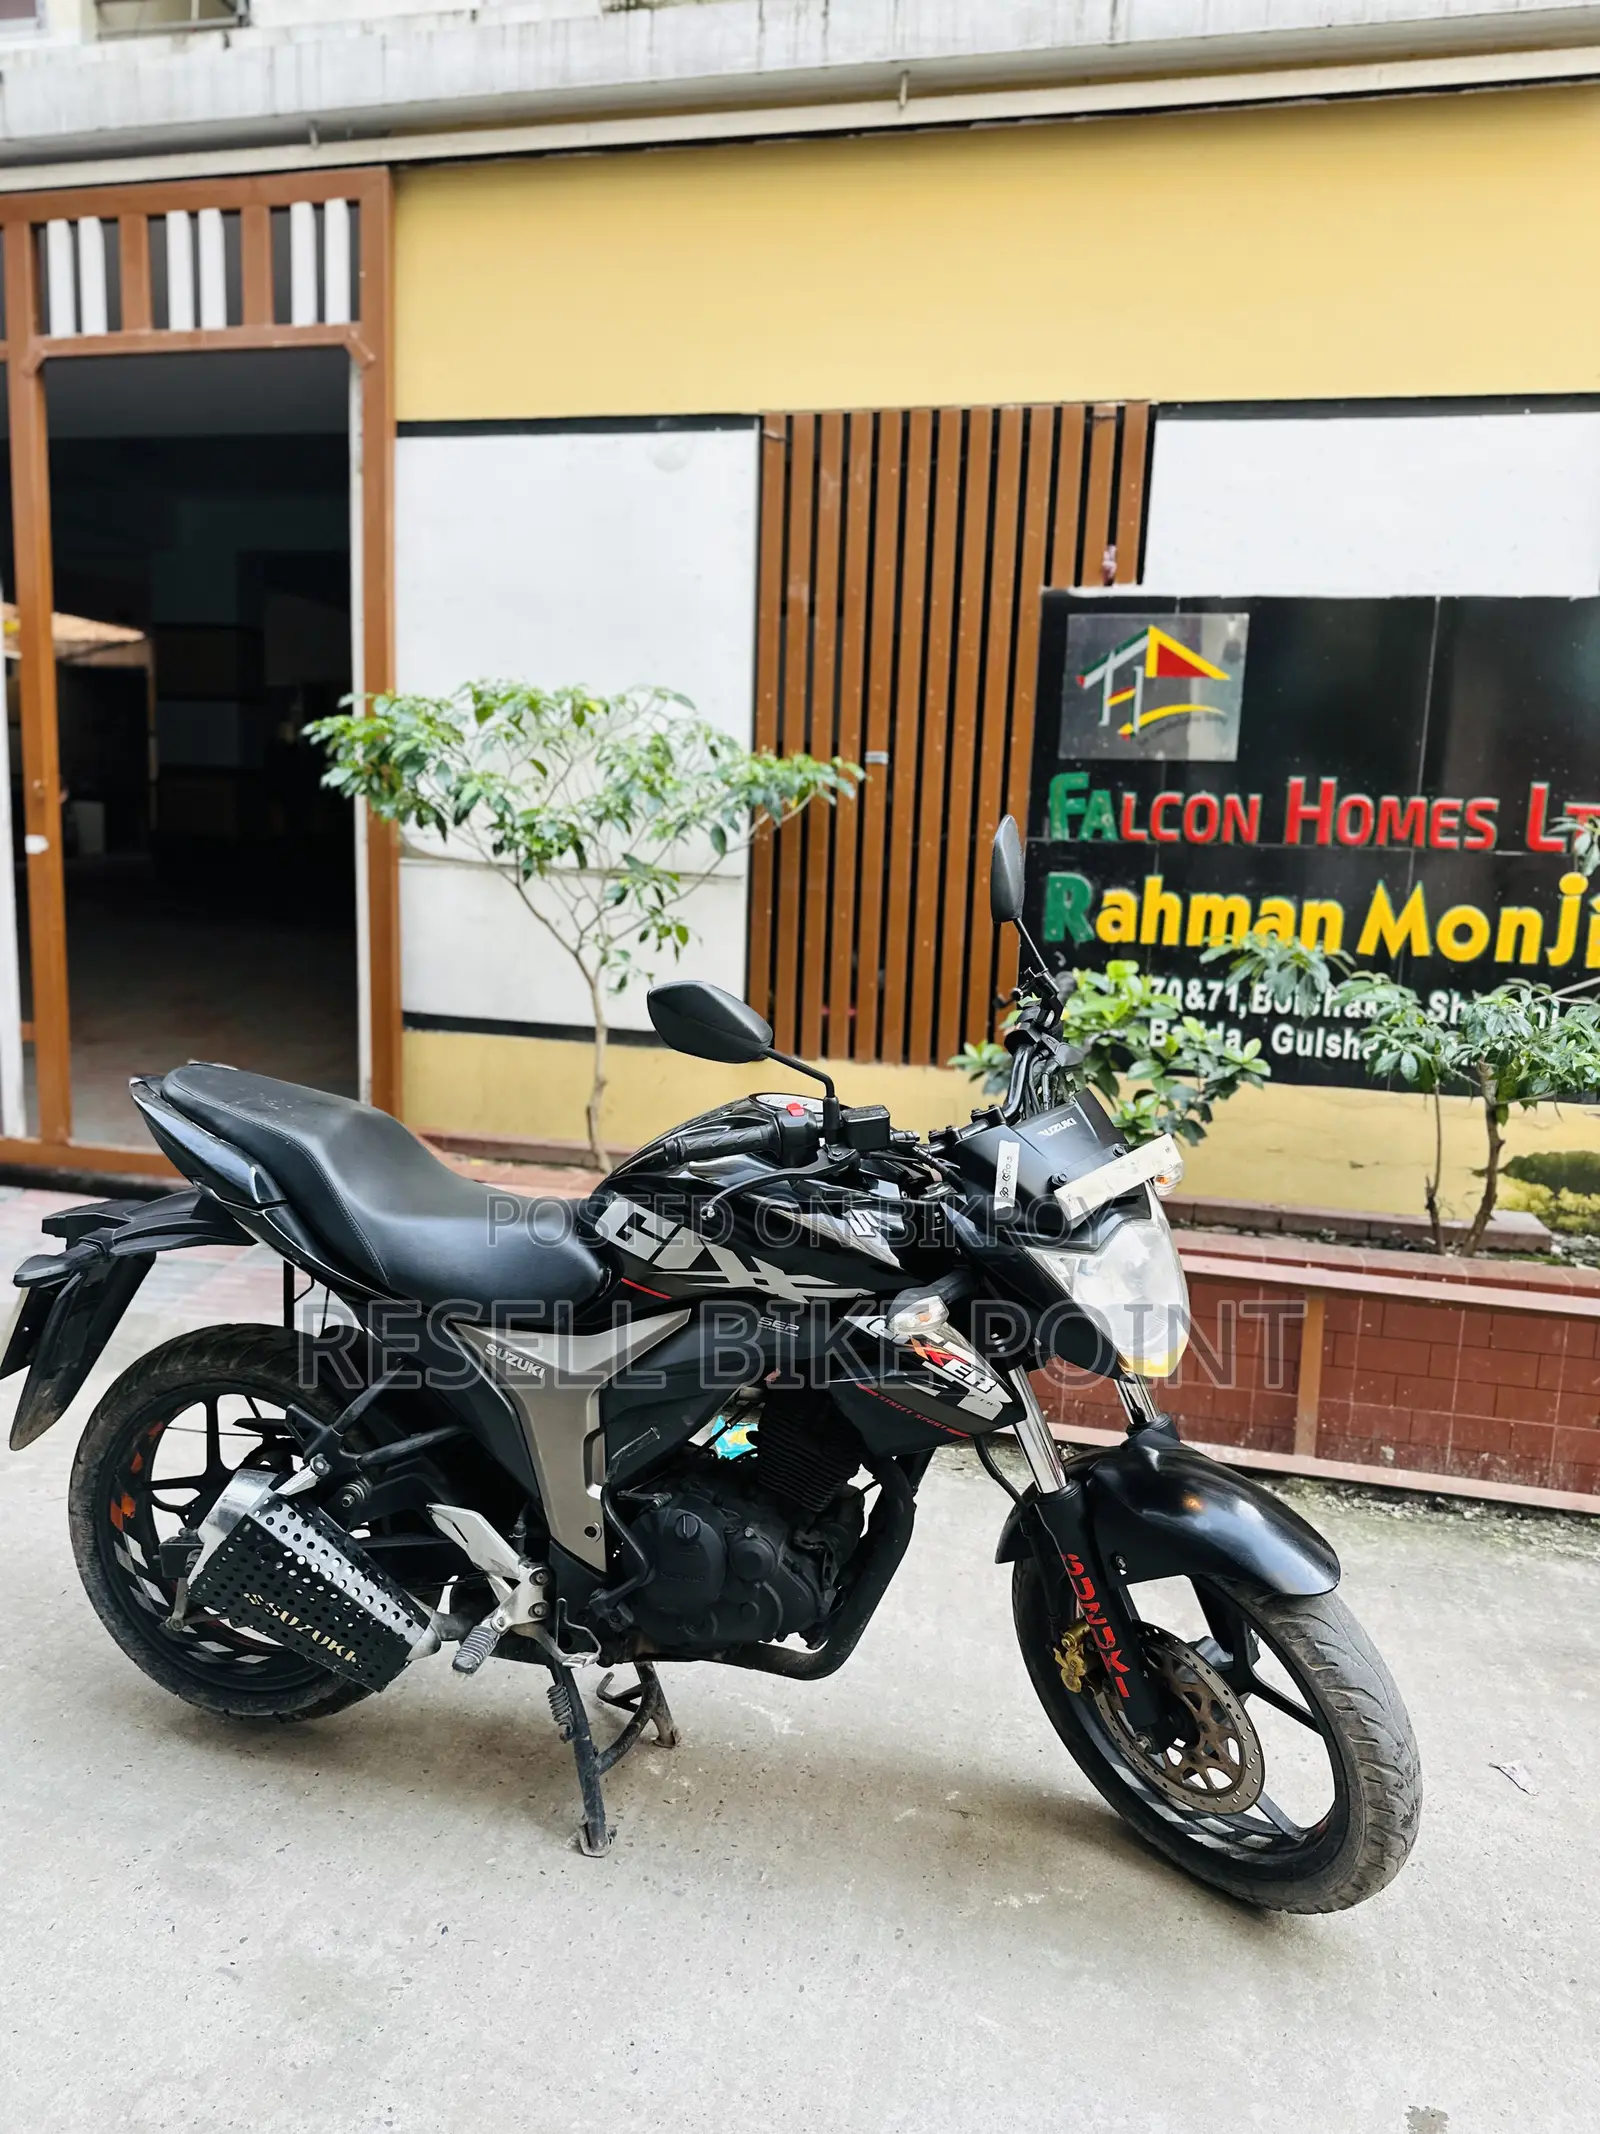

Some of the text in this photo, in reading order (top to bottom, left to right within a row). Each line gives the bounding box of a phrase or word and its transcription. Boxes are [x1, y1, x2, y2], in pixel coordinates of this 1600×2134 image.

[1048, 771, 1262, 844] FALCON
[1284, 776, 1499, 851] HOMES
[1042, 871, 1344, 956] Rahman
[758, 1316, 800, 1331] SEP
[485, 1342, 546, 1379] SUZUKI
[264, 1602, 356, 1663] SUZUKI
